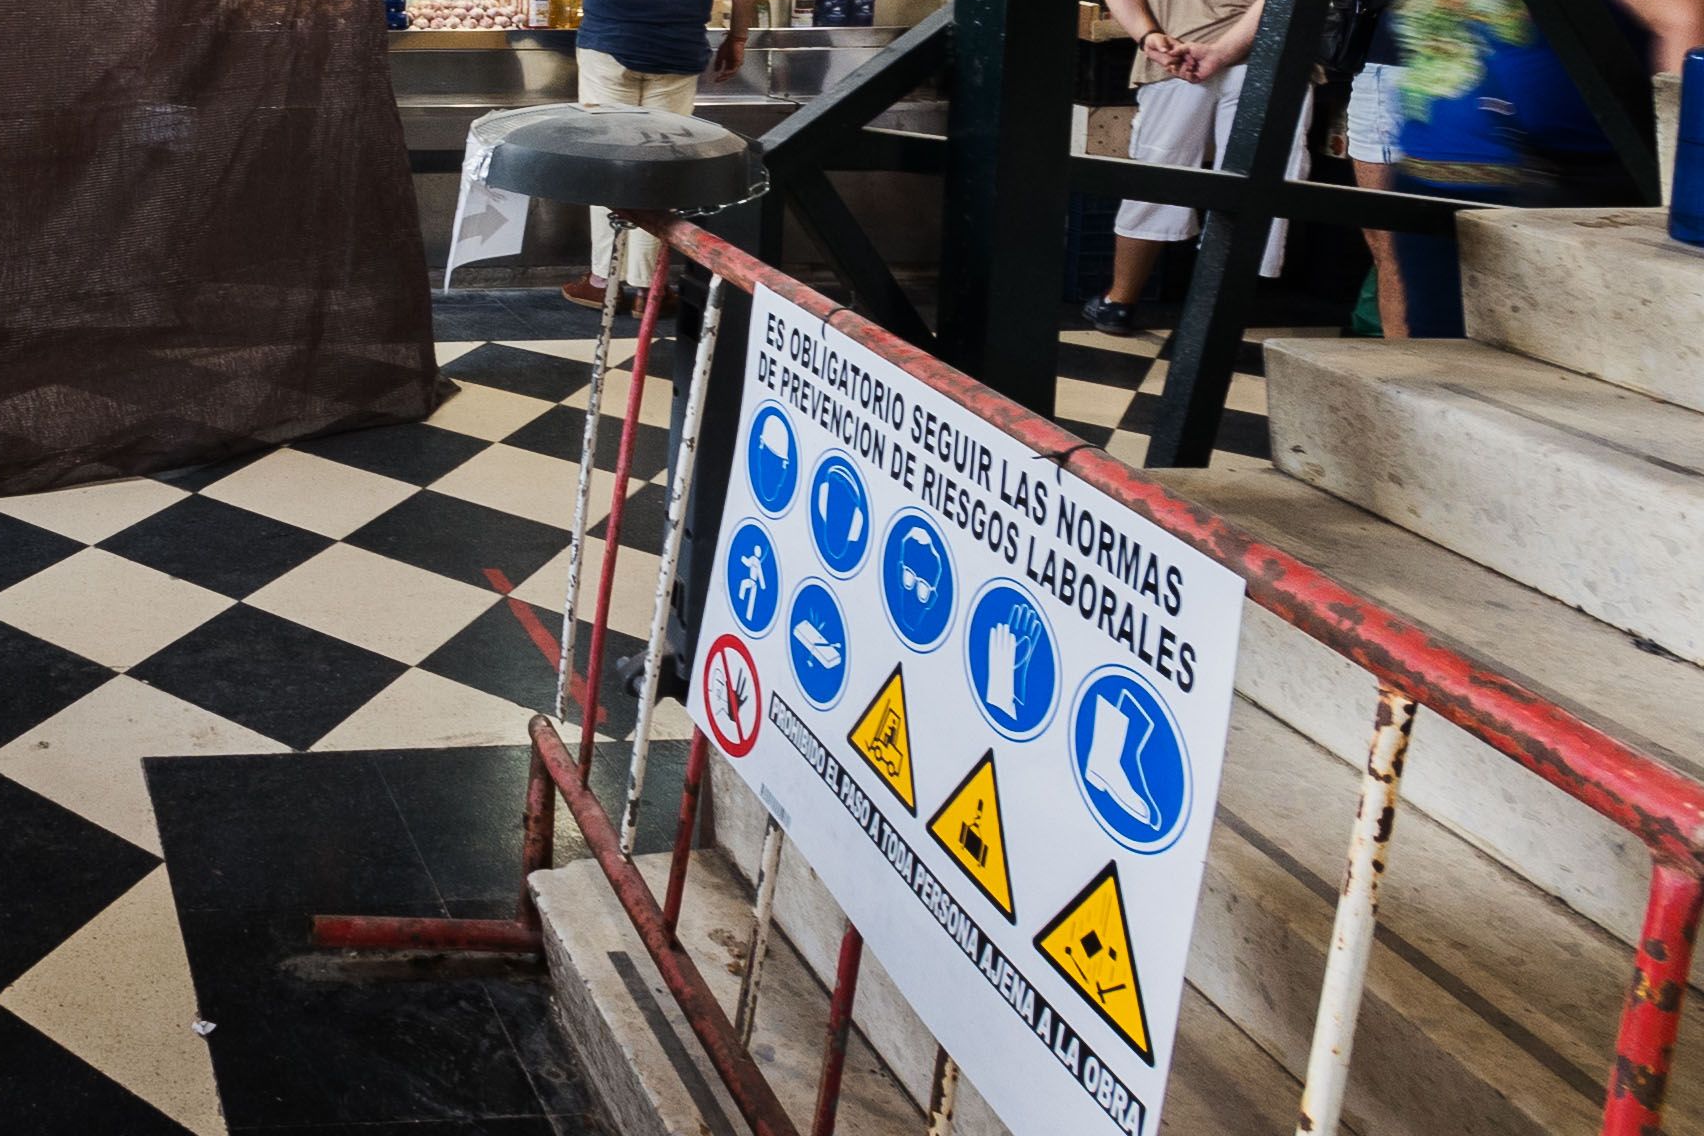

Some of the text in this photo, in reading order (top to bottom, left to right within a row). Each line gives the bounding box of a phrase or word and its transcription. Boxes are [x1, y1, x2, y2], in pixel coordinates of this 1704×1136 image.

[758, 350, 1197, 694] DE PREVENCION DE RIESGOS LABORALES
[766, 312, 1184, 617] ES OBLIGATORIO SEGUIR LAS NORMAS
[770, 695, 826, 775] PROHIBIDO
[824, 756, 840, 793] EL
[840, 774, 872, 828] PASO
[868, 813, 882, 845] A
[879, 821, 915, 885] TODA
[912, 863, 980, 962] PERSONA
[978, 943, 1037, 1026] AJENA
[1036, 1006, 1053, 1045] A
[1053, 1022, 1082, 1076] LA
[1083, 1055, 1142, 1136] OBRA
